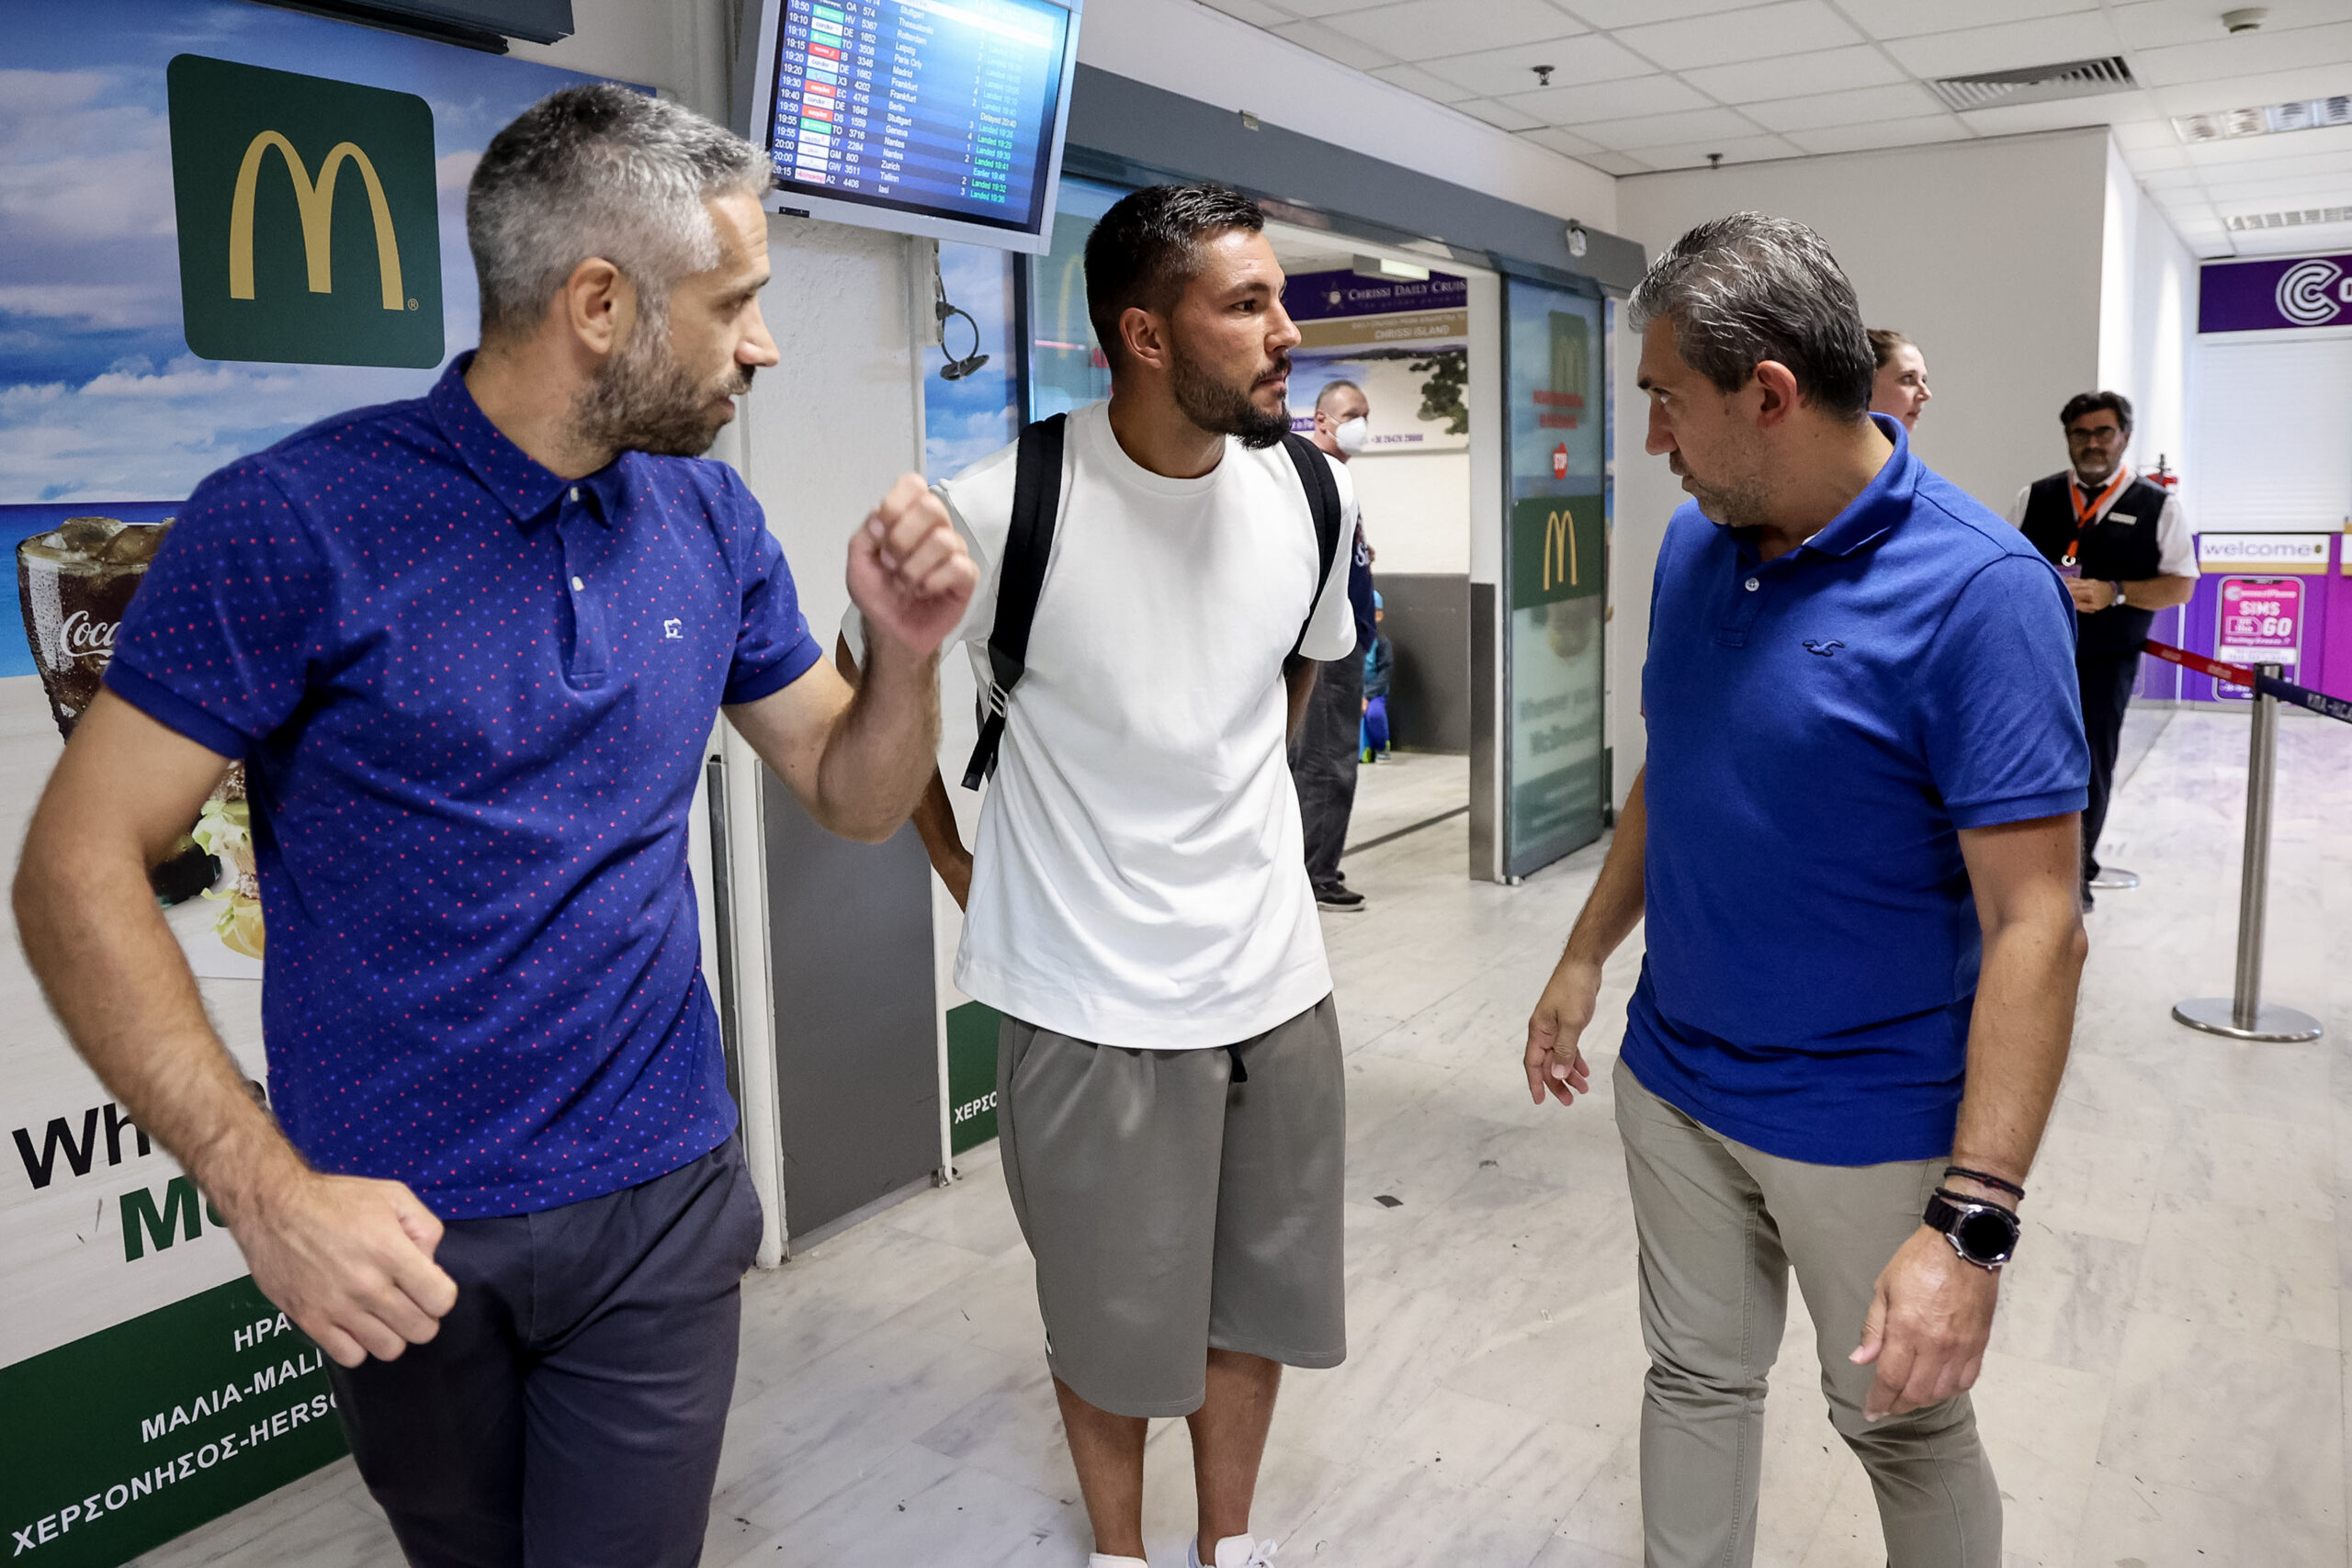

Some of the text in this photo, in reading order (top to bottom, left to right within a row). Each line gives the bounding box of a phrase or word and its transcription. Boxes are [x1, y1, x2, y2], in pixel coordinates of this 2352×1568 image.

[790, 0, 809, 12] 18:50
[845, 14, 855, 25] HV
[846, 2, 857, 12] OA
[863, 6, 876, 17] 574
[787, 24, 807, 38] 19:10
[842, 39, 853, 50] TO
[894, 53, 909, 65] Paris
[910, 58, 922, 70] Orly
[788, 11, 808, 25] 19:10
[843, 27, 854, 38] DE
[896, 41, 916, 56] Leipzig
[785, 50, 804, 62] 19:20
[839, 63, 850, 74] DE
[891, 77, 918, 91] Frankfurt
[786, 37, 805, 50] 19:15
[841, 51, 848, 61] IB
[893, 65, 912, 78] Madrid
[782, 75, 801, 87] 19:30
[836, 88, 847, 98] EC
[853, 92, 869, 104] 4745
[888, 101, 905, 112] Berlin
[783, 62, 802, 74] 19:20
[838, 76, 847, 85] X3
[890, 89, 916, 103] Frankfurt
[779, 100, 798, 112] 19:50
[833, 112, 844, 122] DS
[886, 124, 908, 137] Geneva
[976, 144, 995, 156] Landed
[780, 87, 799, 100] 19:40
[835, 100, 845, 110] DE
[887, 113, 911, 127] Stuttgart
[978, 134, 997, 145] Landed
[776, 126, 796, 138] 19:55
[831, 137, 840, 147] V7
[883, 148, 903, 160] Nantes
[778, 113, 797, 125] 19:55
[832, 125, 842, 134] TO
[849, 129, 865, 140] 3716
[884, 136, 905, 148] Nantes
[975, 156, 993, 167] Landed
[774, 151, 793, 162] 20:00
[828, 161, 841, 171] GW
[844, 164, 860, 175] 3511
[880, 172, 899, 183] Tallinn
[970, 189, 989, 199] Landed
[775, 138, 794, 150] 20:00
[830, 149, 842, 159] GM
[845, 152, 859, 163] 800
[881, 160, 900, 171] Zurich
[971, 178, 990, 189] Landed
[826, 175, 835, 184] A2
[1394, 283, 1428, 296] DAILY
[1413, 324, 1451, 337] ISLAND
[2205, 540, 2312, 557] welcome
[2239, 600, 2280, 616] SIMS
[2262, 616, 2292, 637] GO
[119, 1175, 231, 1262] M
